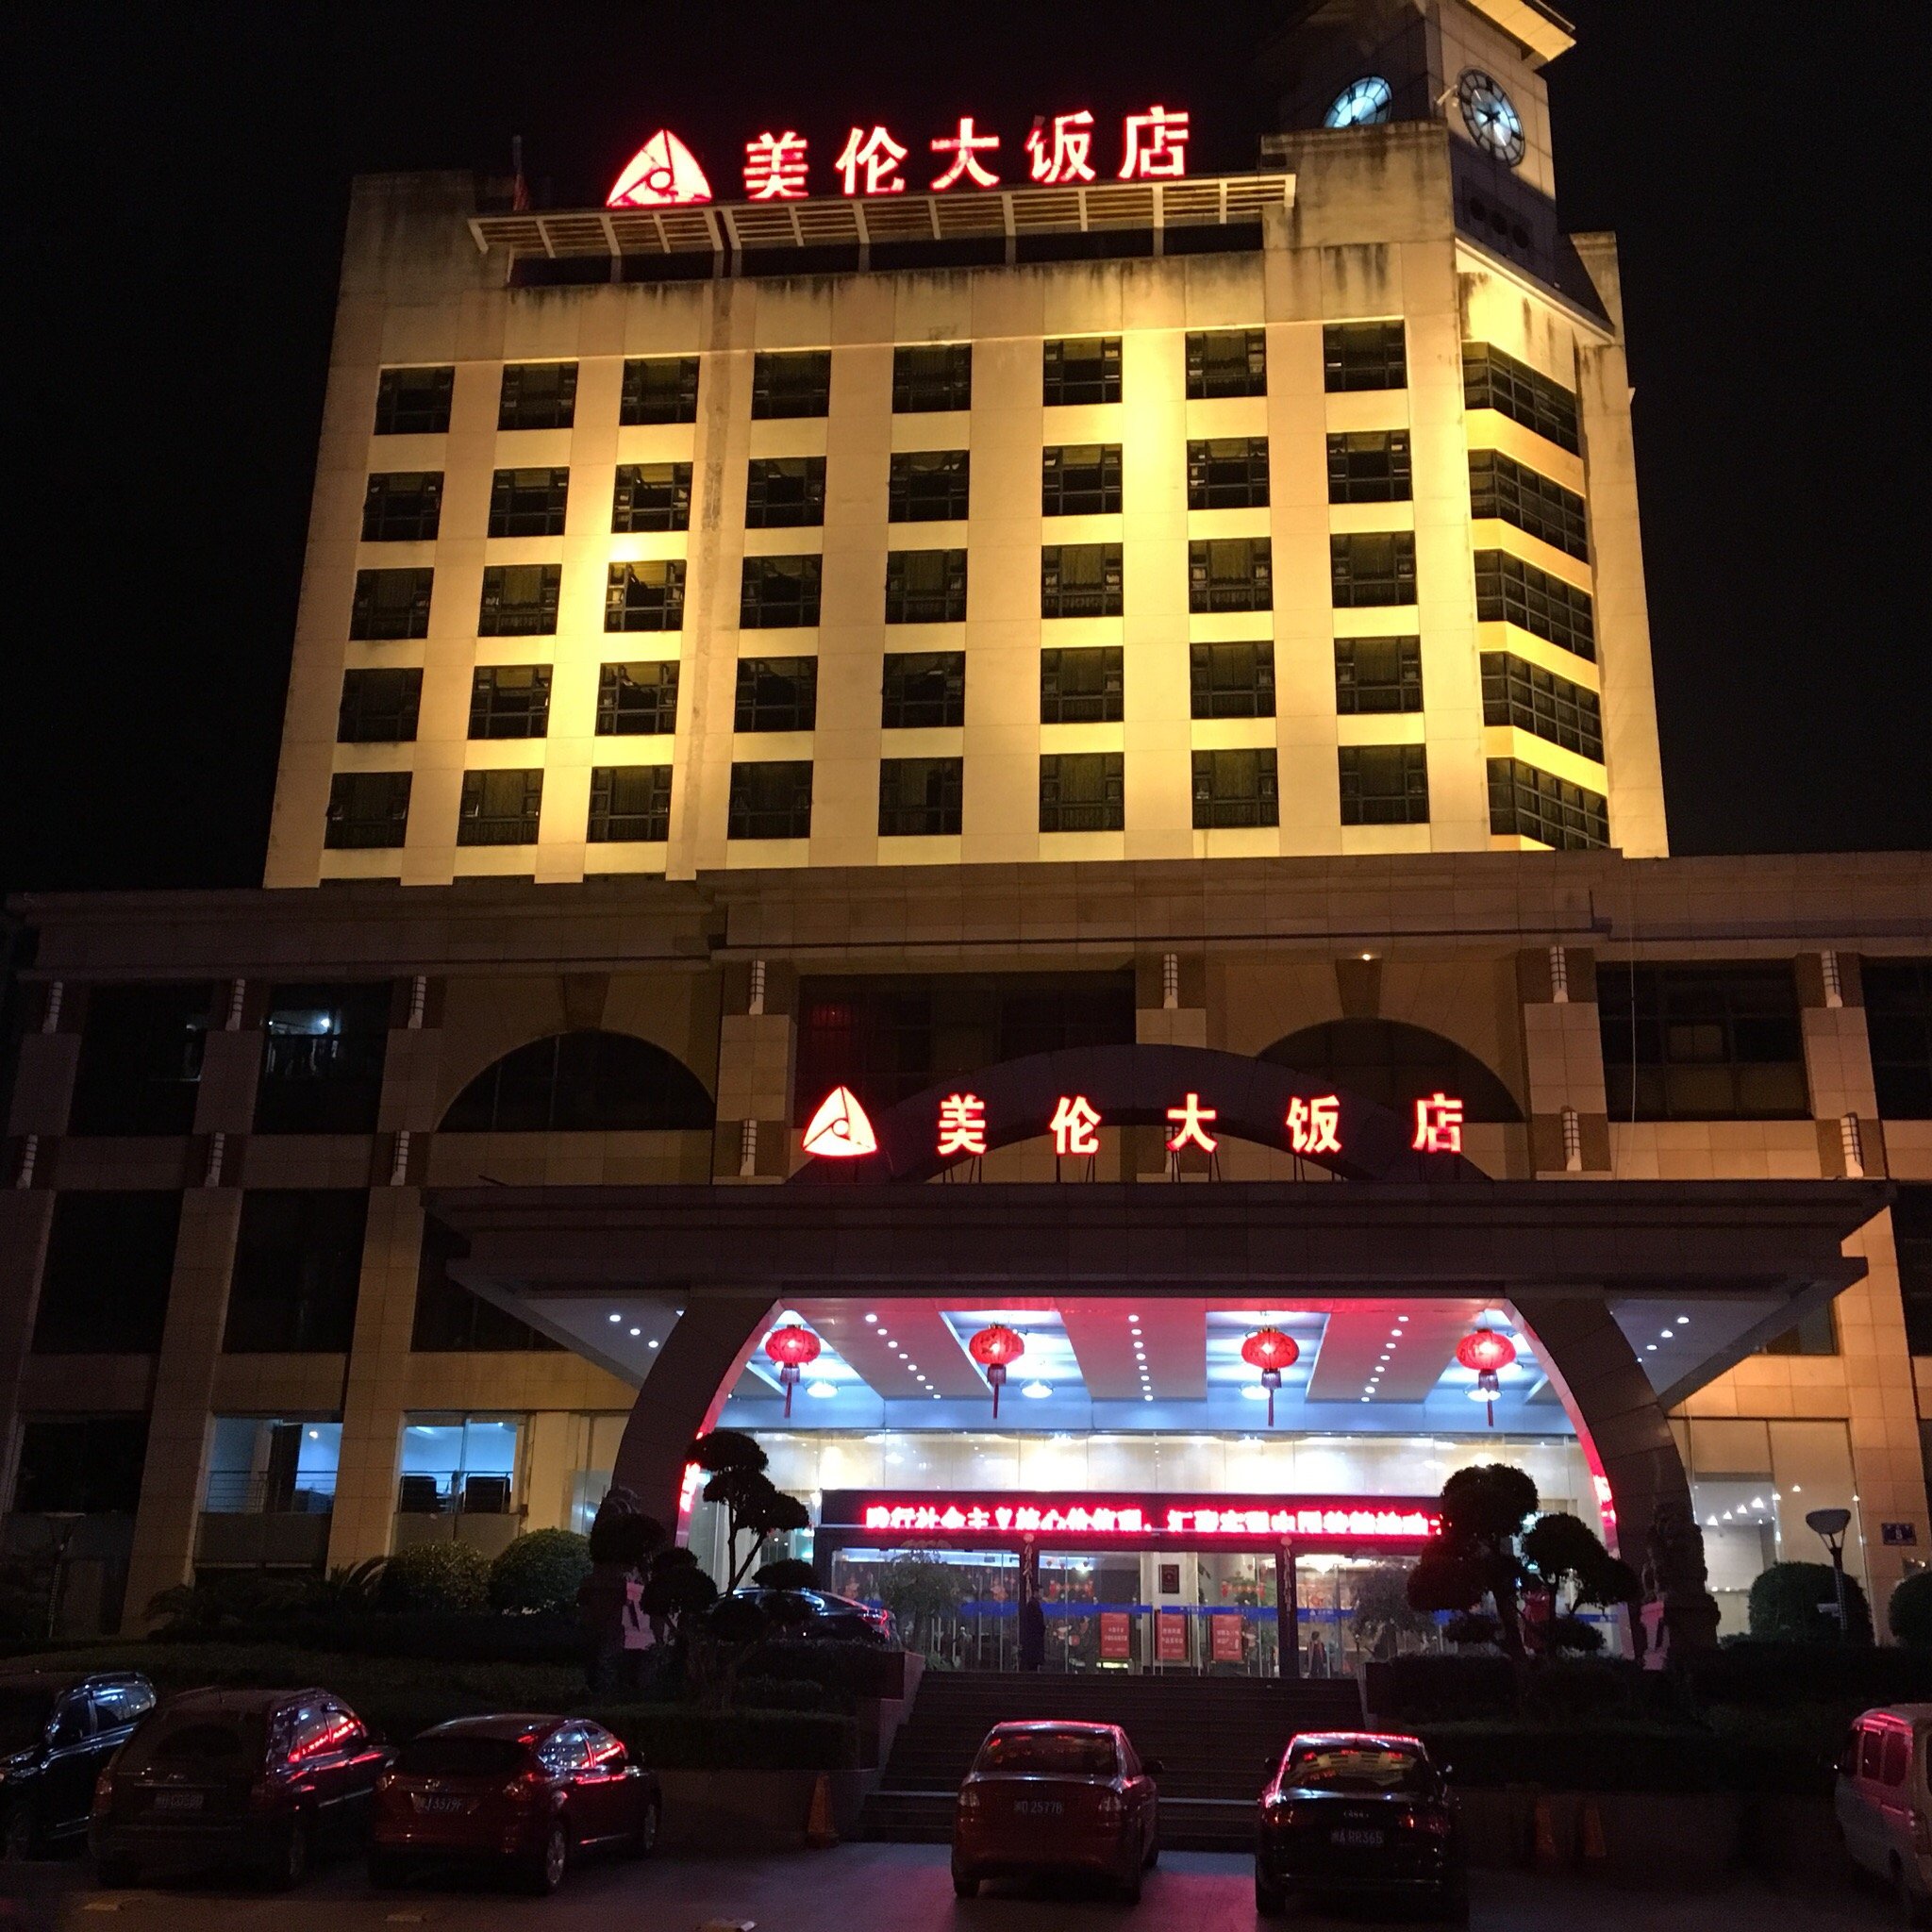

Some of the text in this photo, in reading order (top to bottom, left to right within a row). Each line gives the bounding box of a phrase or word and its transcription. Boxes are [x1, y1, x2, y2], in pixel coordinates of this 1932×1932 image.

[742, 105, 1190, 200] 美伦大饭店
[938, 1093, 1463, 1155] 美伦大饭店
